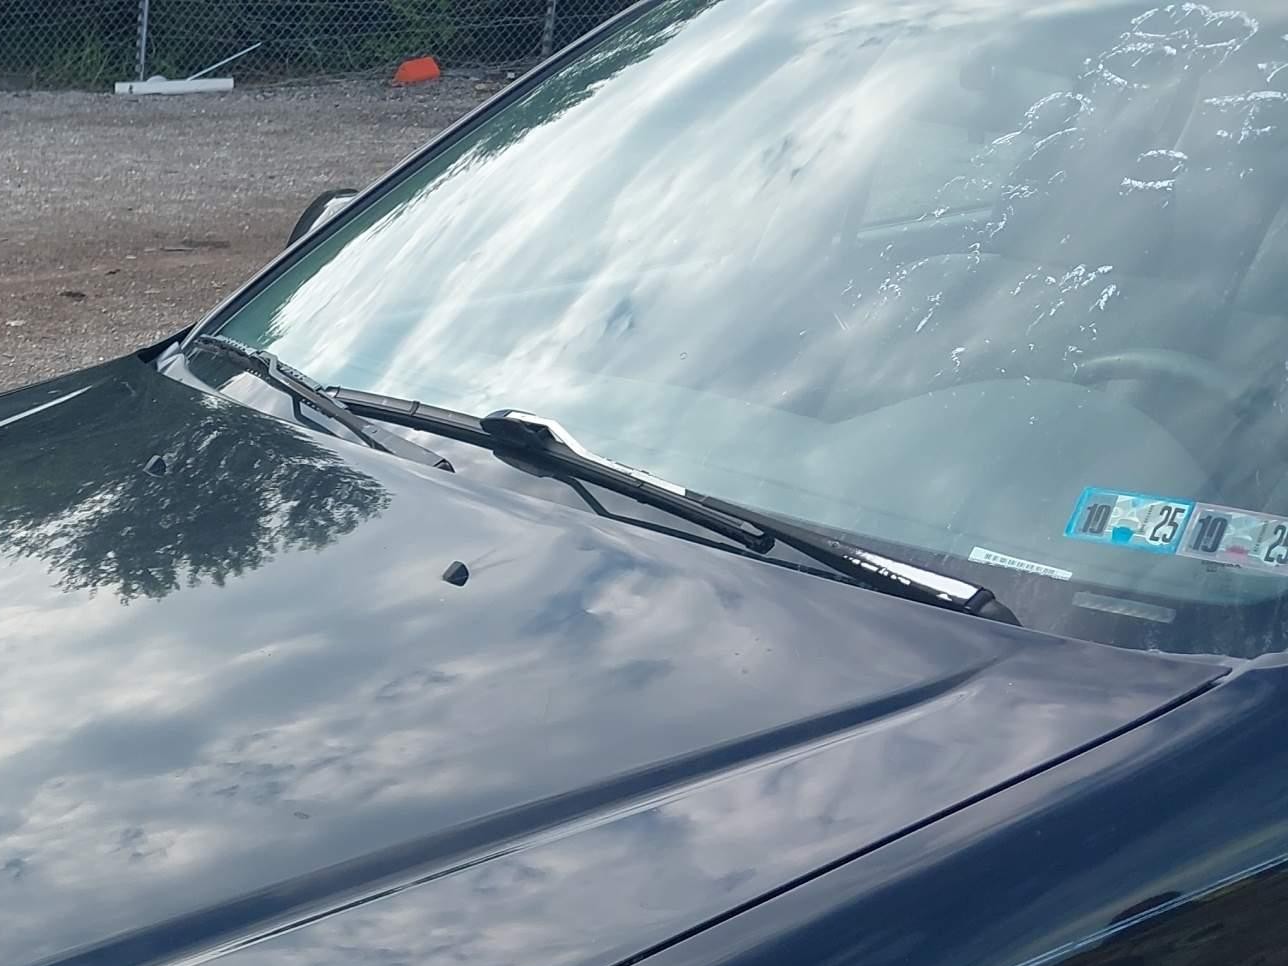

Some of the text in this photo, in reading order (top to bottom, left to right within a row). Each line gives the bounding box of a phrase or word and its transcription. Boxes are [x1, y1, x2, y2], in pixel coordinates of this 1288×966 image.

[1081, 503, 1112, 535] 10
[1149, 505, 1187, 544] 25
[1192, 514, 1228, 553] 10
